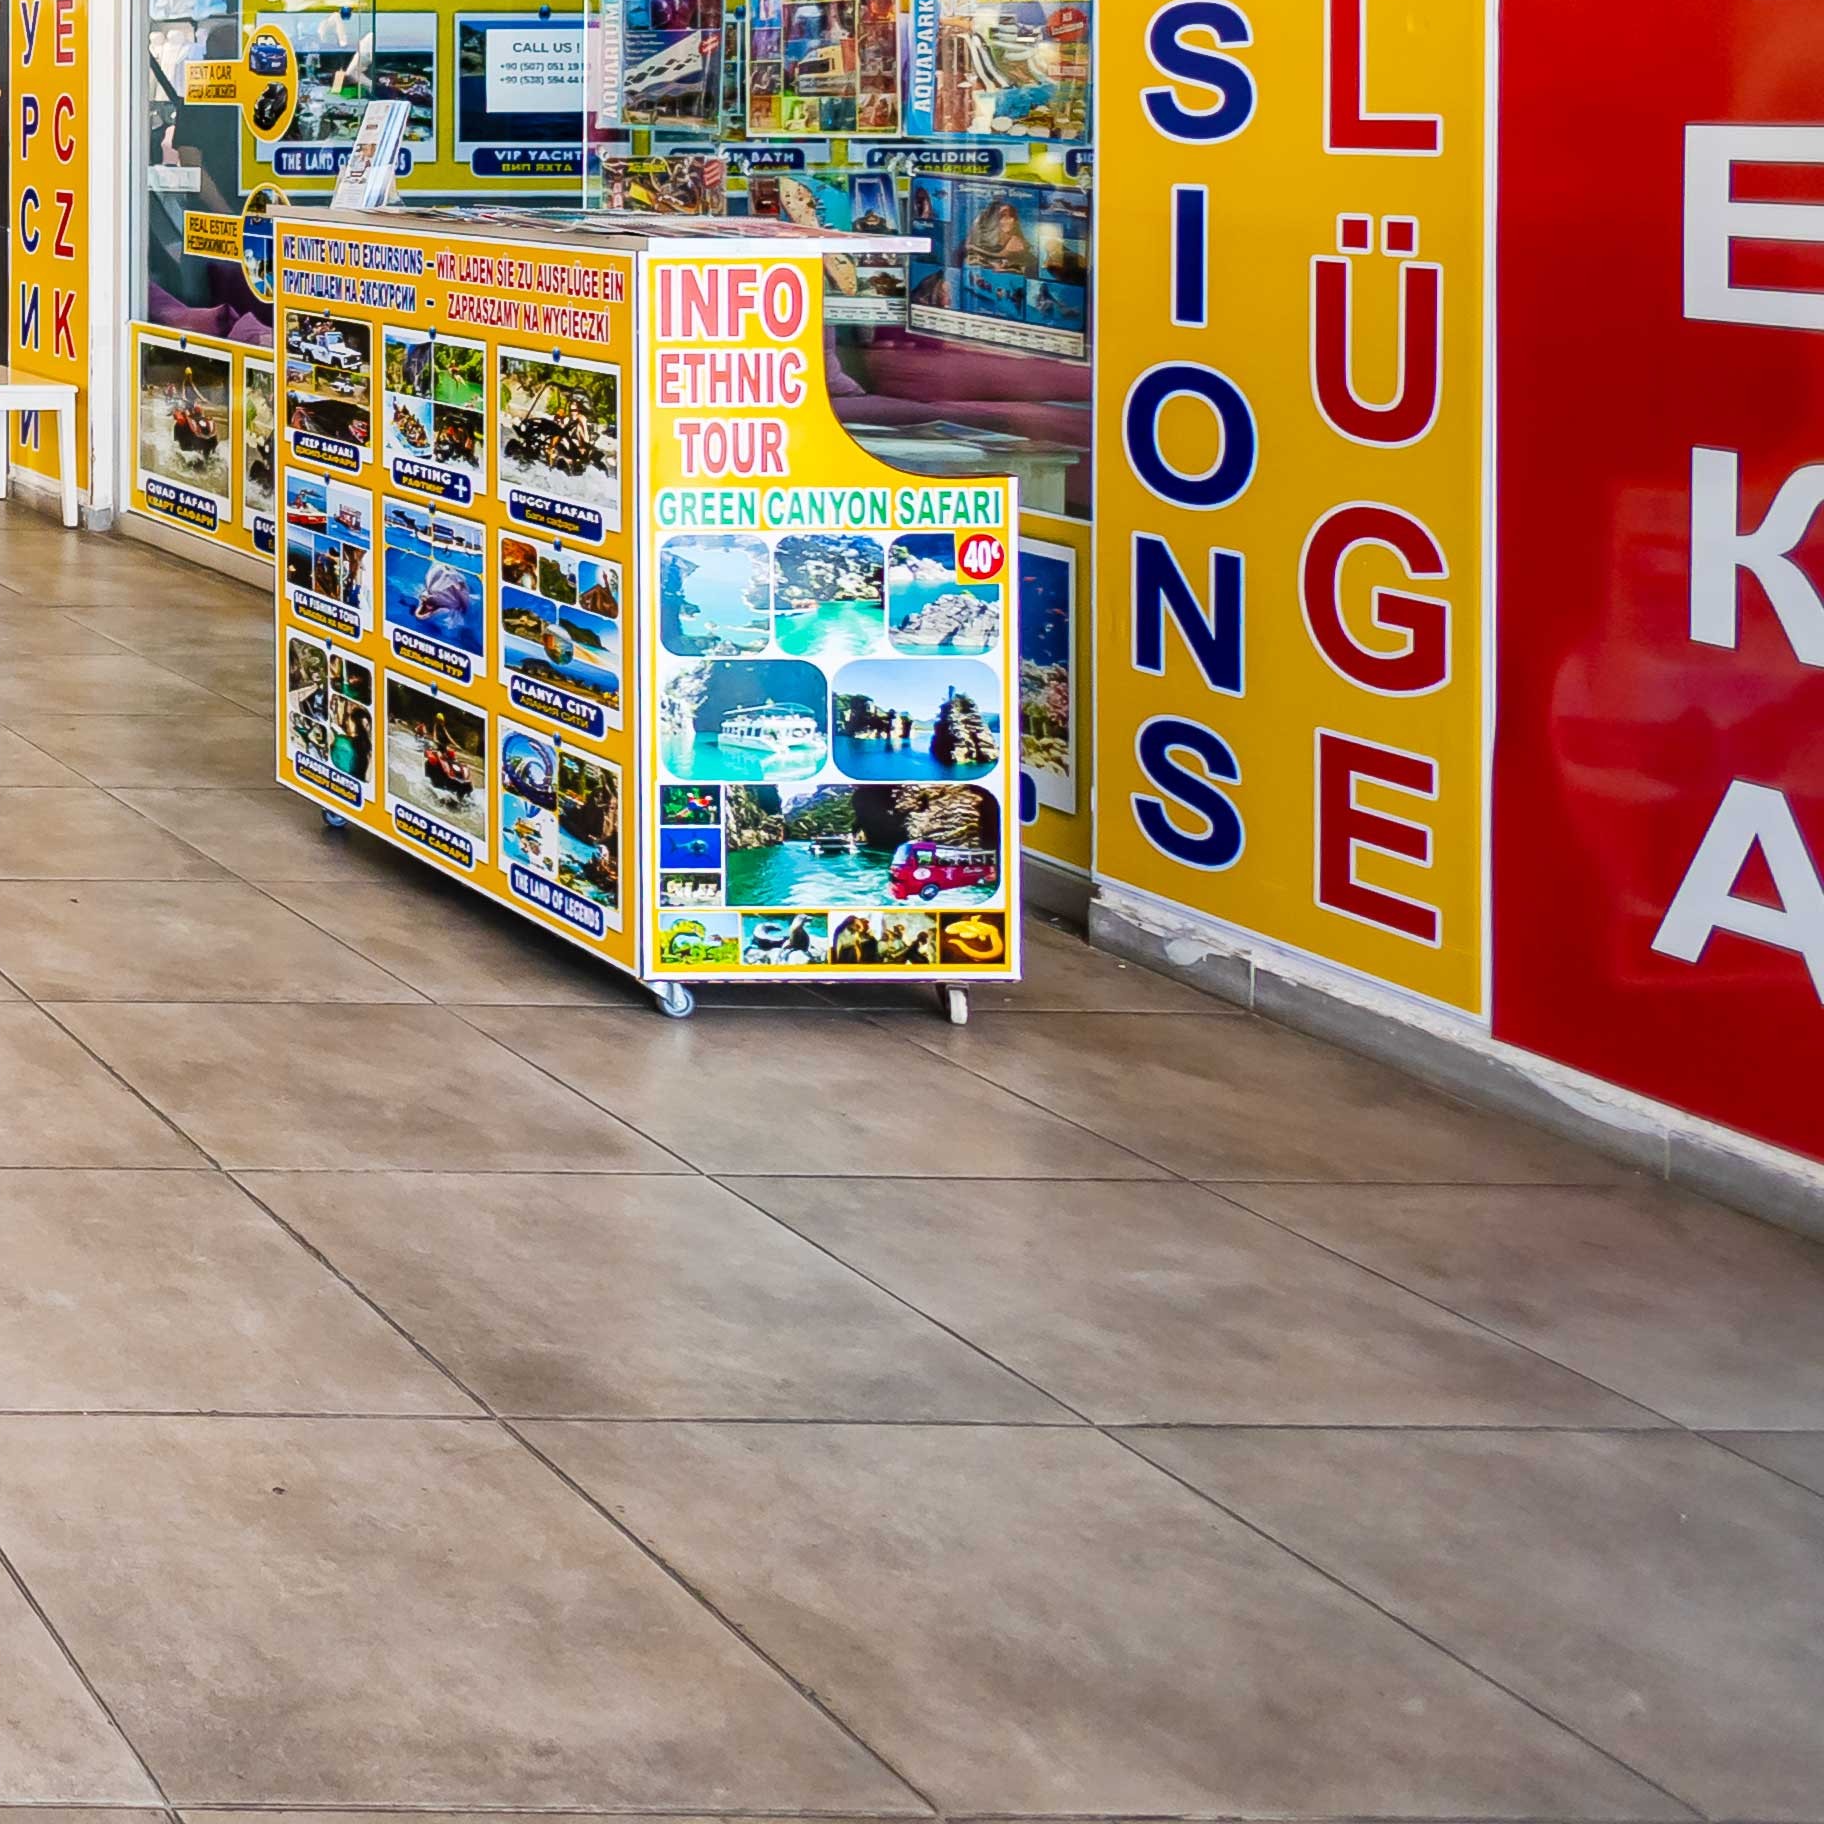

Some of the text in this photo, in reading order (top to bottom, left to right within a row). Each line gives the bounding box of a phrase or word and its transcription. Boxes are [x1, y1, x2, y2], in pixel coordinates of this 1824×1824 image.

[513, 42, 572, 53] CALL US
[216, 65, 232, 80] CAR
[500, 62, 517, 71] +90
[500, 76, 517, 85] +90
[282, 153, 333, 170] THE LAND
[494, 150, 583, 161] VIP YACHT
[502, 163, 573, 172] ВИП ЯХТА
[189, 219, 238, 238] REAL ESTATE
[283, 236, 532, 290] WE INVITE YOU TO EXCURSIONS LADEN ZU
[345, 279, 357, 302] НА
[360, 280, 416, 311] ЭКСКУРСИИ
[448, 293, 520, 328] ZAPRASZAMY
[524, 303, 539, 331] NA
[659, 266, 804, 338] INFO
[660, 352, 803, 404] ETHNIC
[300, 437, 354, 458] JEEP SAFARI
[678, 422, 784, 473] TOUR
[396, 460, 451, 485] RAFTING
[148, 483, 215, 514] QUAD SAFARI
[511, 492, 599, 524] BUGGY SAFARI
[660, 490, 1000, 525] GREEN CANYON SAFARI
[296, 592, 308, 605] SEA
[395, 631, 469, 667] DOLPHIN SHOW
[512, 679, 597, 721] ALANYA CITY
[397, 809, 470, 852] QUAD SAFARI
[515, 870, 600, 931] THE LAND OF LEGENDS
